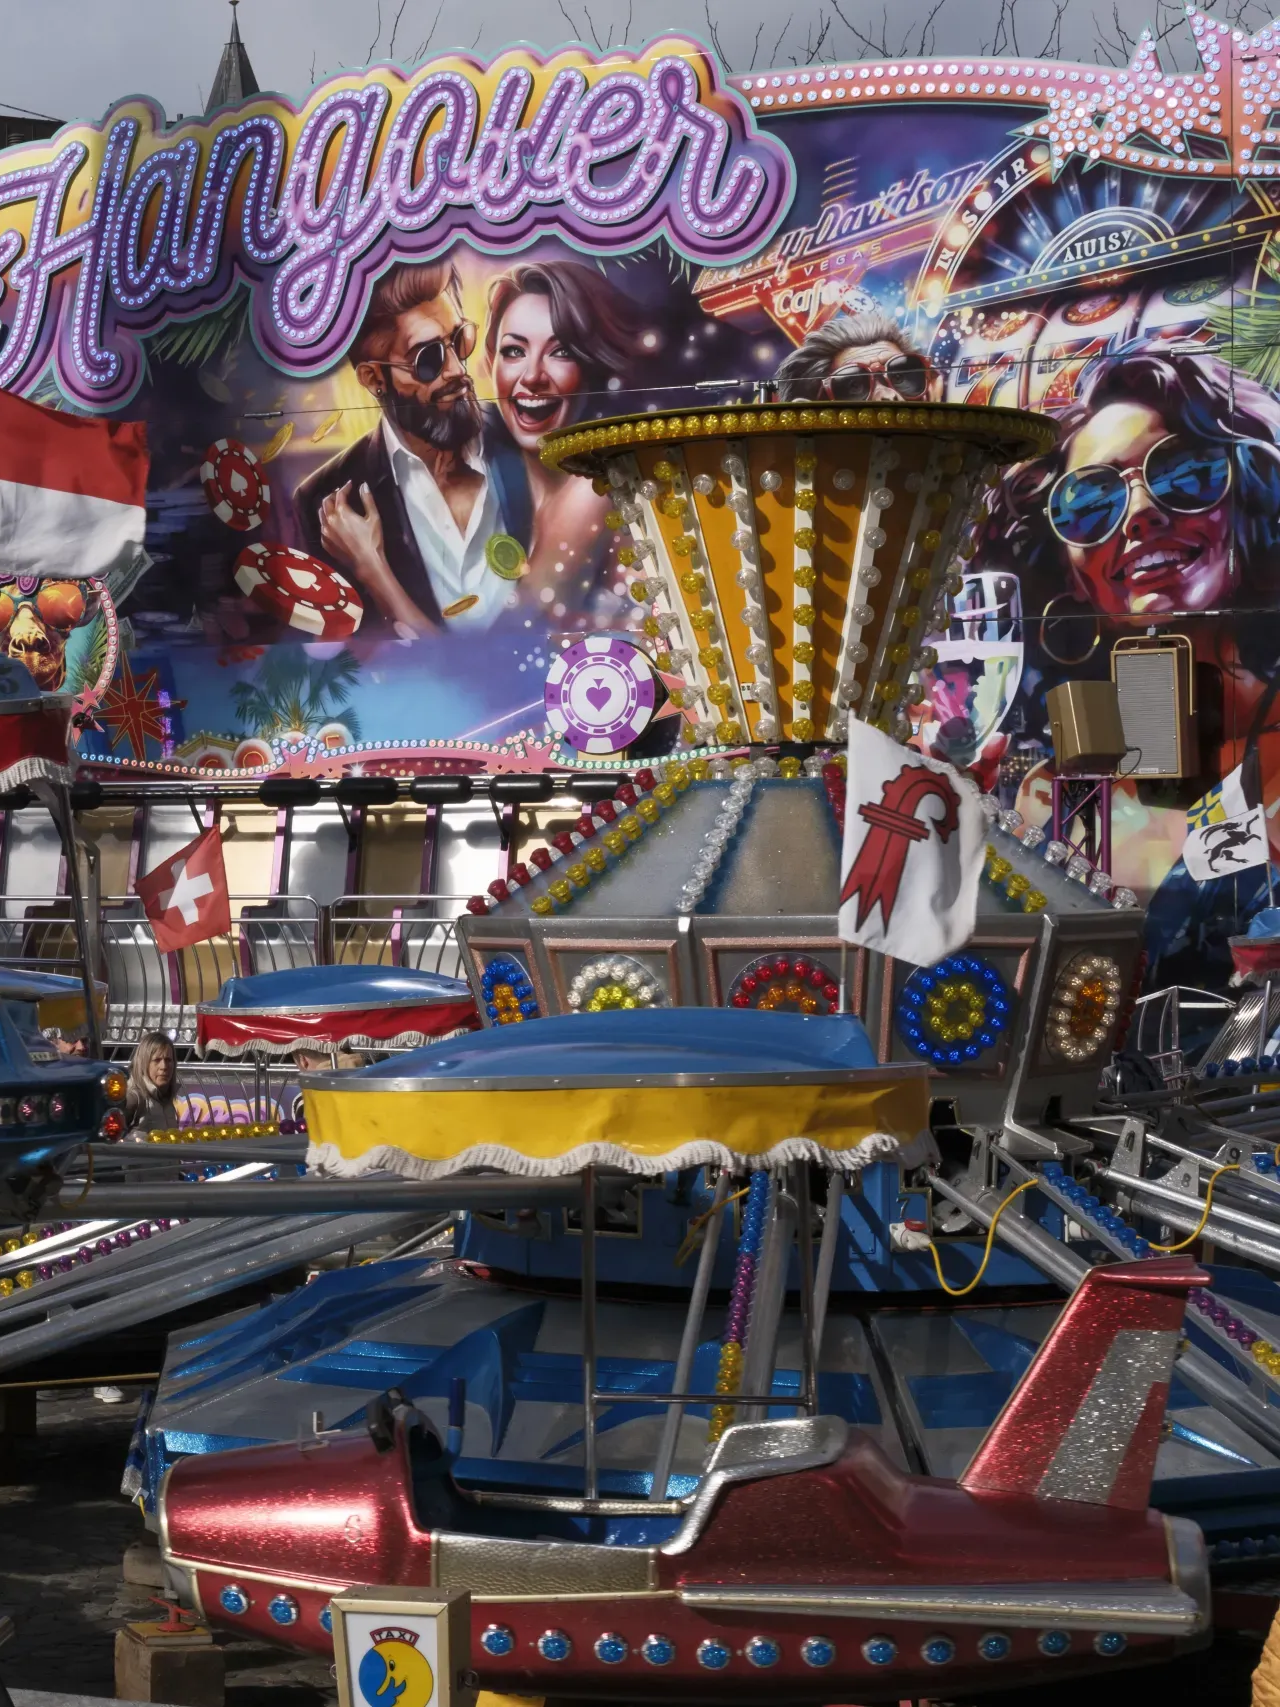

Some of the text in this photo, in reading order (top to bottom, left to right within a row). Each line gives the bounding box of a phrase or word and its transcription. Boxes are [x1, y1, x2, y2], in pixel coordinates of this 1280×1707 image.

[803, 242, 882, 277] VEGAS
[773, 278, 832, 328] Caf
[344, 1513, 363, 1544] 6
[376, 1630, 414, 1643] TAXI
